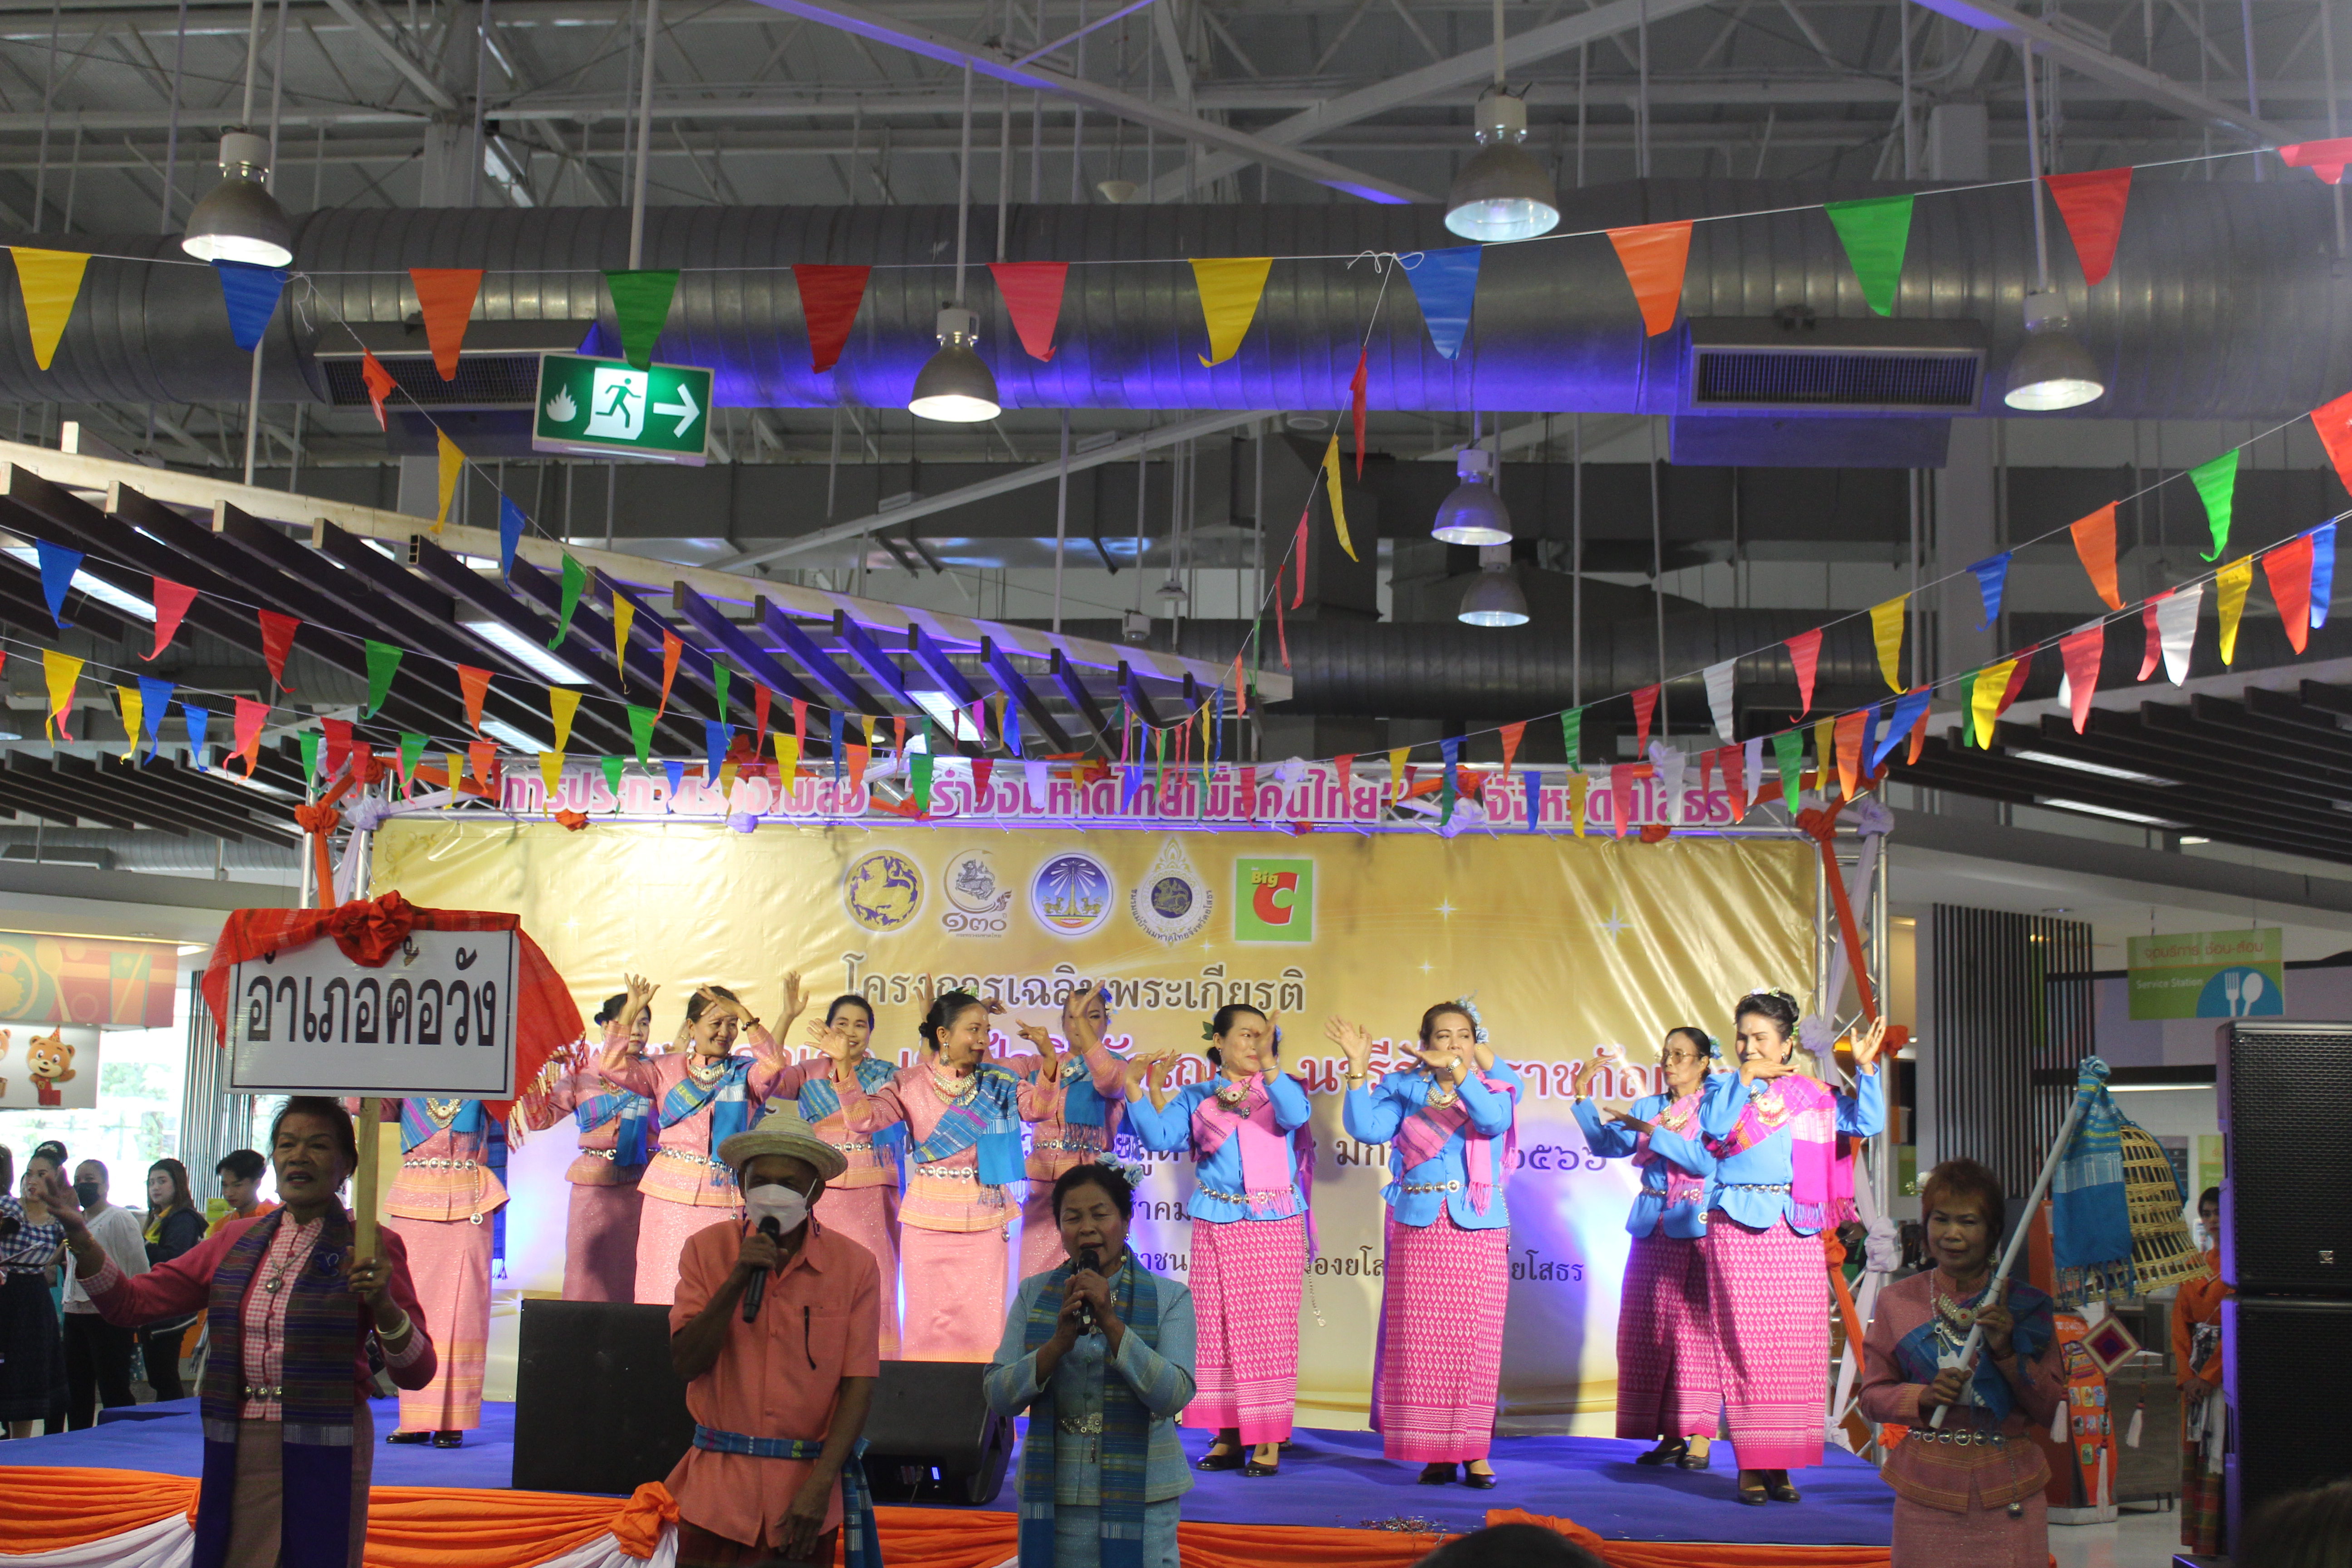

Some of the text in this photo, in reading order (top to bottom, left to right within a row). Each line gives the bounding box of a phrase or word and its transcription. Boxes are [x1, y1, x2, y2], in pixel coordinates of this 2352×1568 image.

[1251, 871, 1279, 888] Big
[1253, 872, 1299, 926] C
[843, 953, 1303, 1013] โครงการเฉลิพระเกียรติ
[2136, 977, 2204, 990] Service Station
